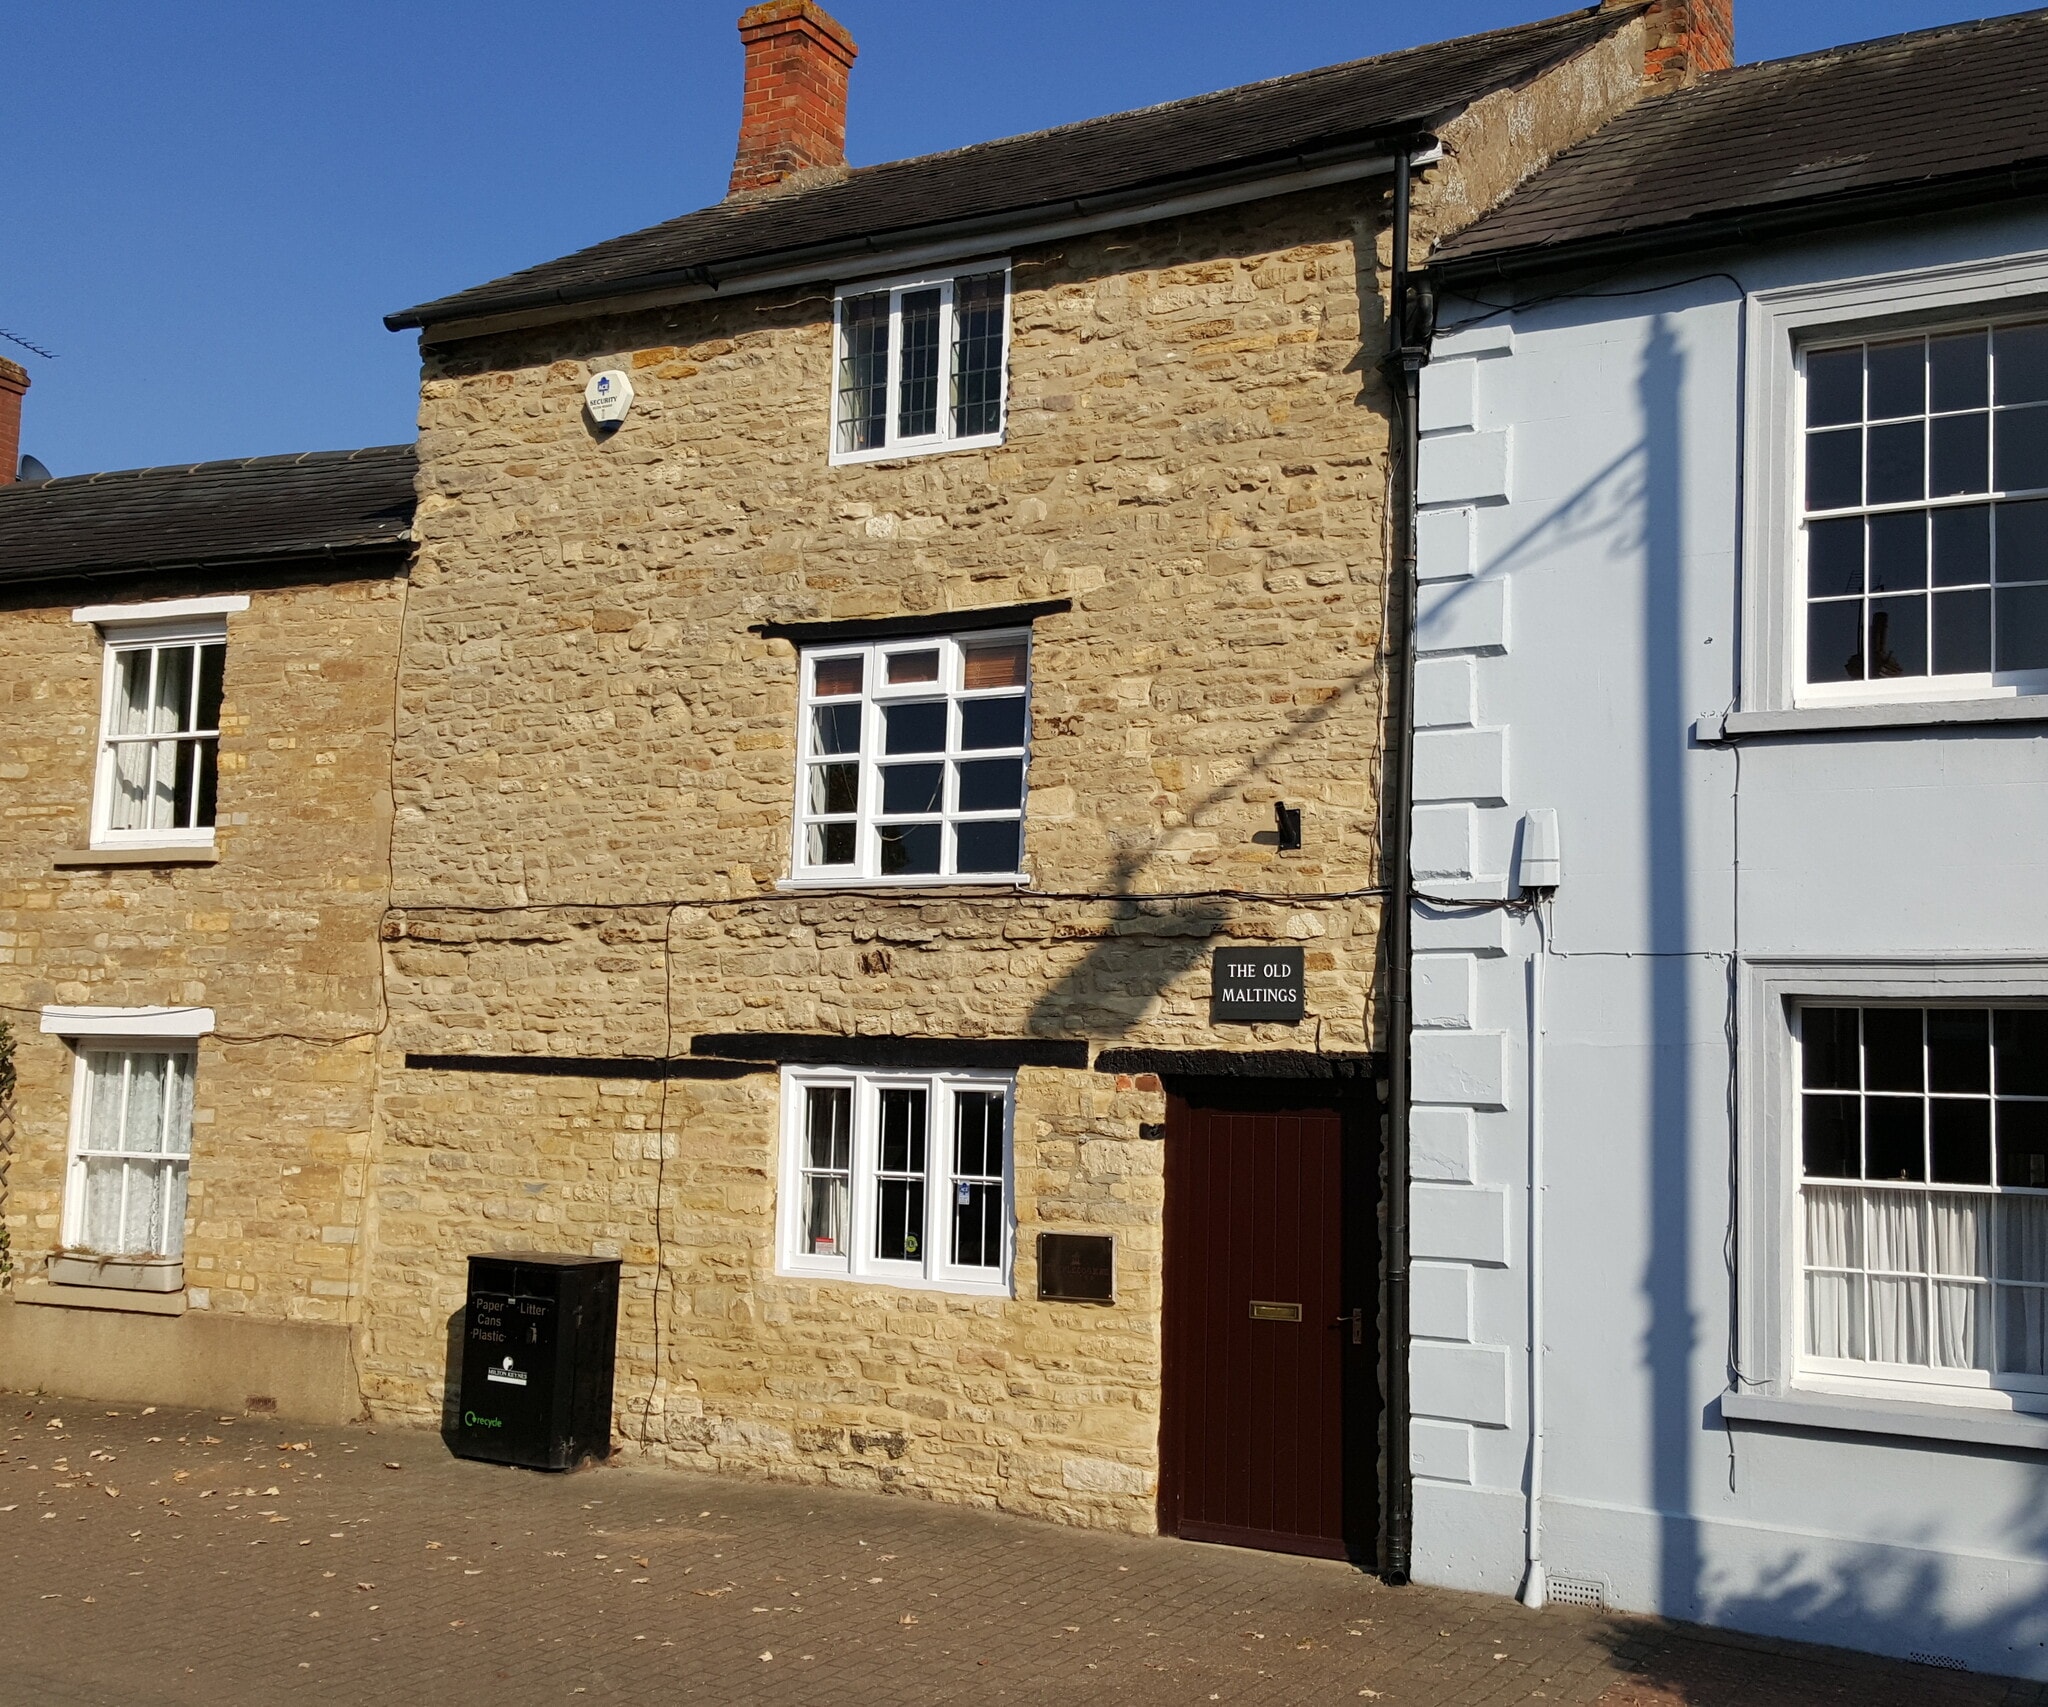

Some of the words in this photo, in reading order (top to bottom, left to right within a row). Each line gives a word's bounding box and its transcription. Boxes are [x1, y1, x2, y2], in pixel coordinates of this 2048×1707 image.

[590, 396, 617, 406] SECURITY
[1227, 964, 1256, 978] THE
[1263, 964, 1291, 978] OLD
[1222, 988, 1297, 1003] MALTINGS
[476, 1298, 504, 1313] Paper
[520, 1302, 546, 1316] Litter
[477, 1313, 502, 1327] Cans
[472, 1328, 505, 1342] Plastic
[488, 1369, 507, 1377] MILTON
[476, 1417, 502, 1429] recycle
